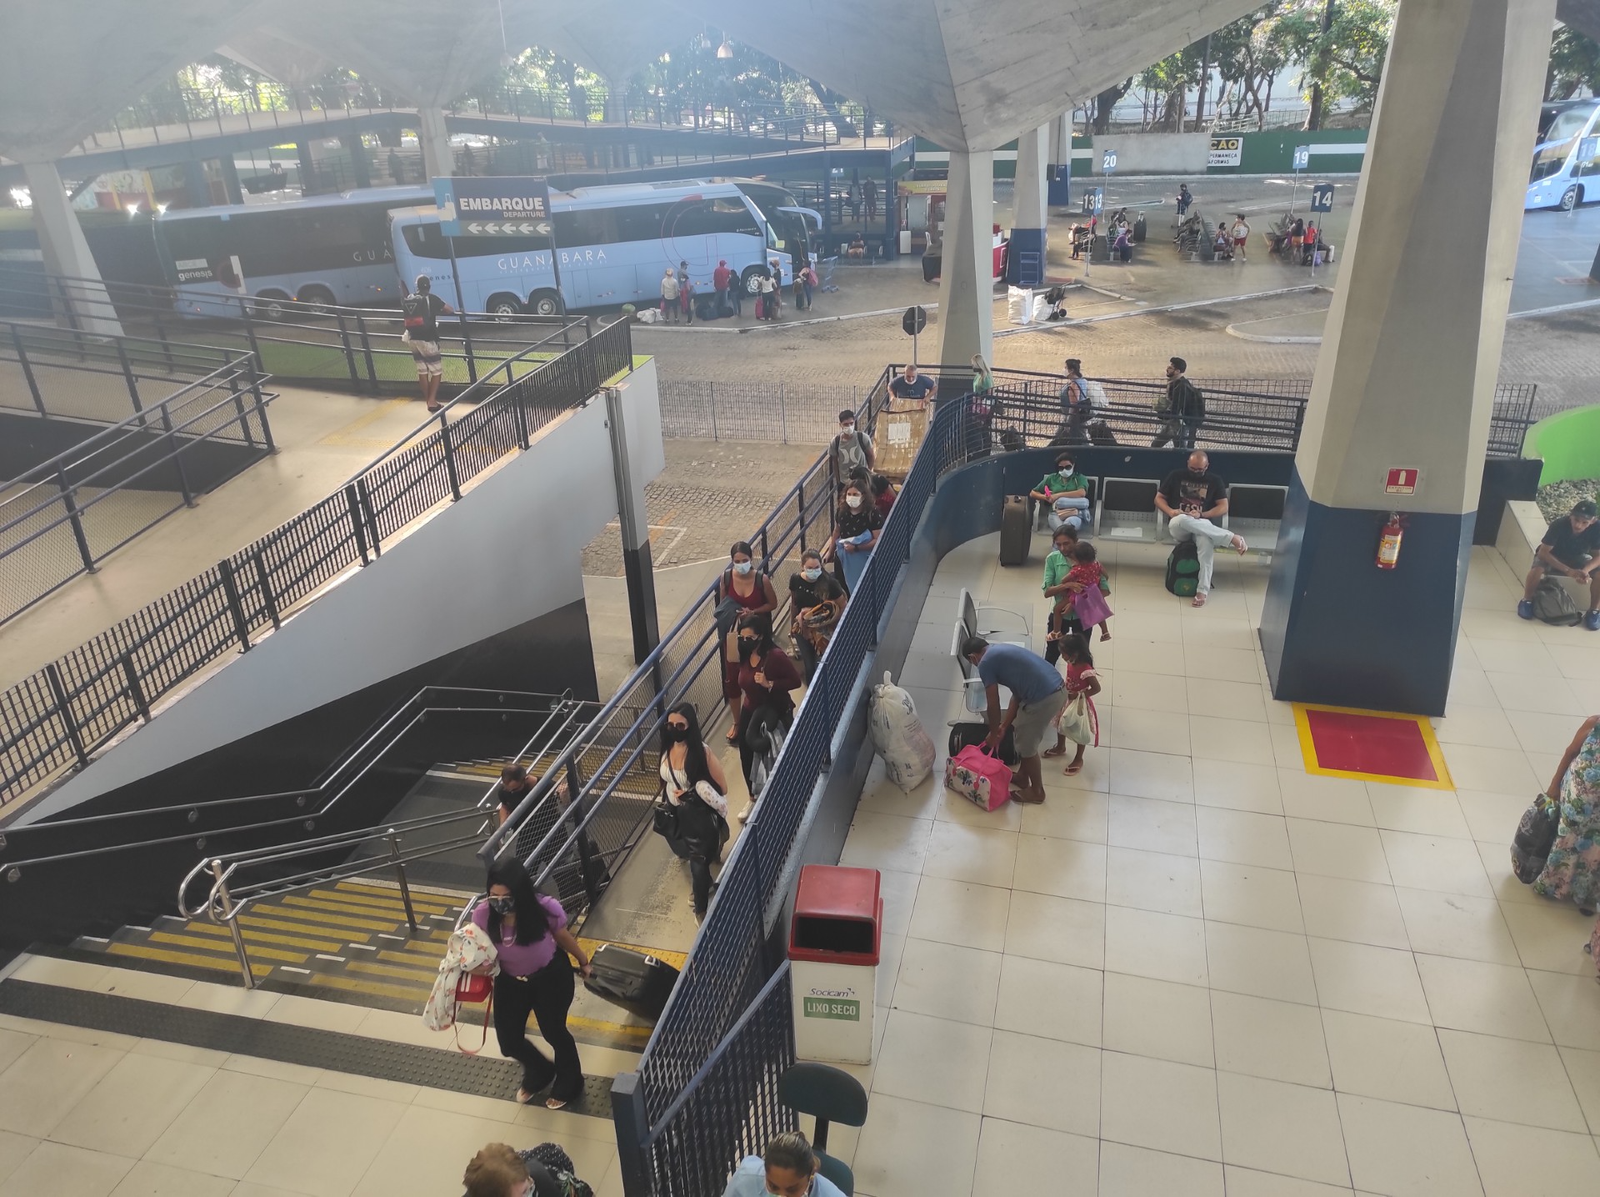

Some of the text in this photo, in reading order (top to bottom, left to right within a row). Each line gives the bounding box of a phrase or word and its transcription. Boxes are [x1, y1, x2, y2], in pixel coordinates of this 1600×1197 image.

[1581, 143, 1596, 157] 18
[1103, 155, 1117, 168] 20
[1294, 151, 1309, 165] 19
[459, 197, 545, 211] EMBARQUE
[1083, 194, 1095, 210] 13
[1313, 191, 1333, 207] 14
[178, 270, 212, 281] genesis
[810, 988, 849, 997] Socicam
[807, 1002, 856, 1016] LIXO SECO
